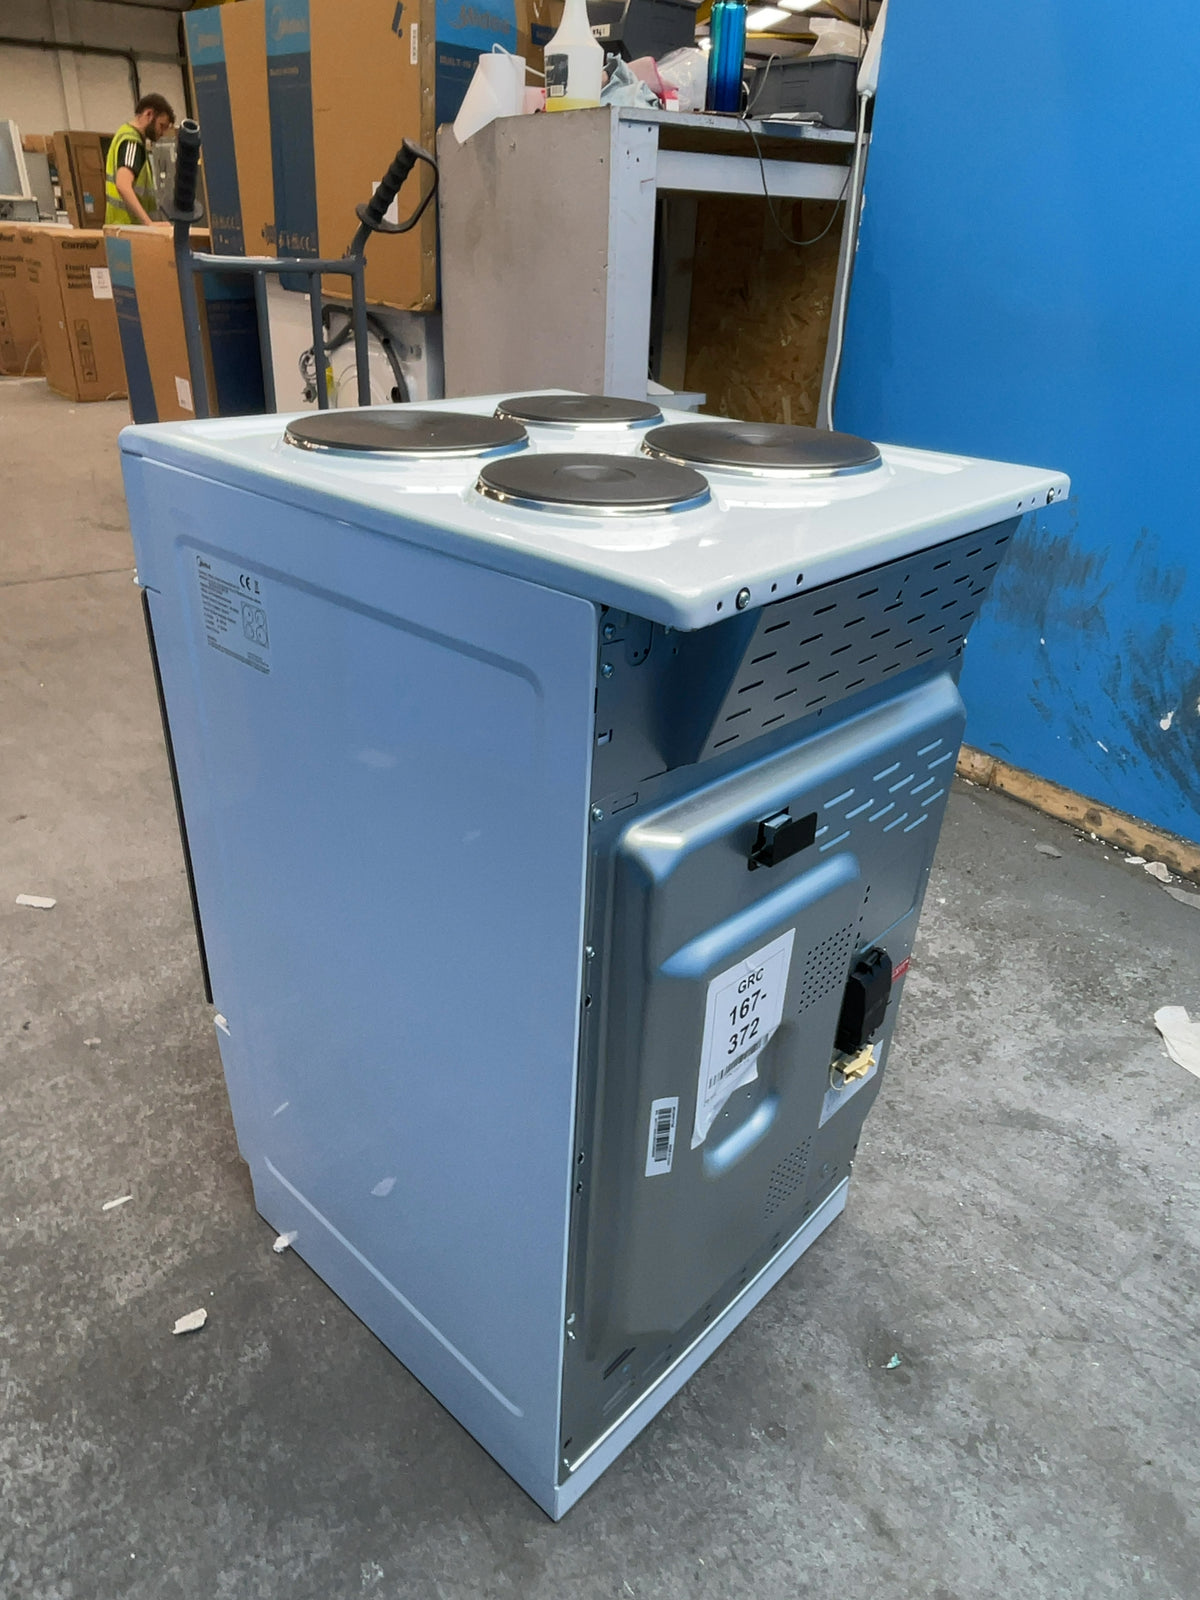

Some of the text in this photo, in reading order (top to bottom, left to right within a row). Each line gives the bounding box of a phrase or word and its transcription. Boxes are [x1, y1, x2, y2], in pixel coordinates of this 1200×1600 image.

[737, 967, 765, 994] GRC
[729, 988, 768, 1026] 167-
[727, 1016, 761, 1055] 372
